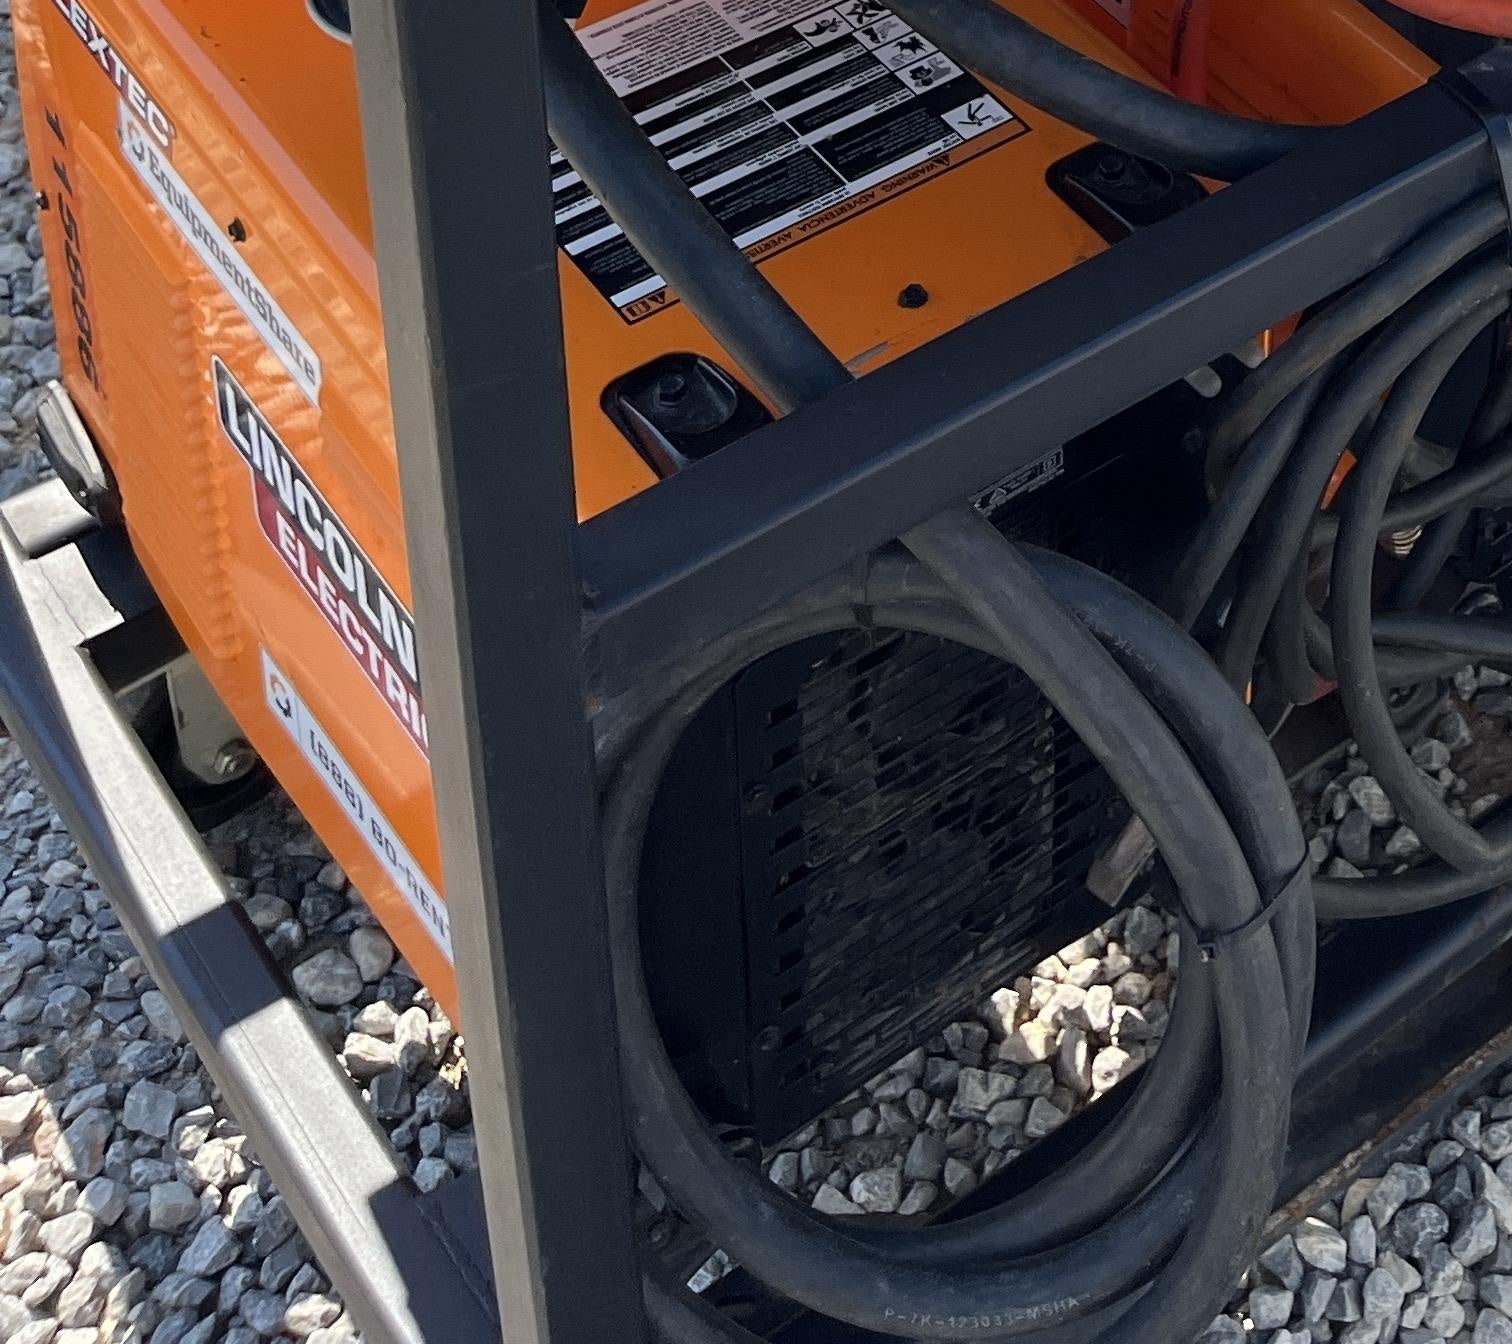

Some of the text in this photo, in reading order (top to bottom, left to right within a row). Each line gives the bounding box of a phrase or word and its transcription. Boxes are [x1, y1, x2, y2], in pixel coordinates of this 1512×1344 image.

[148, 147, 318, 388] EquipmentShare
[225, 382, 418, 683] LINCOLN
[370, 815, 450, 939] 80-REN
